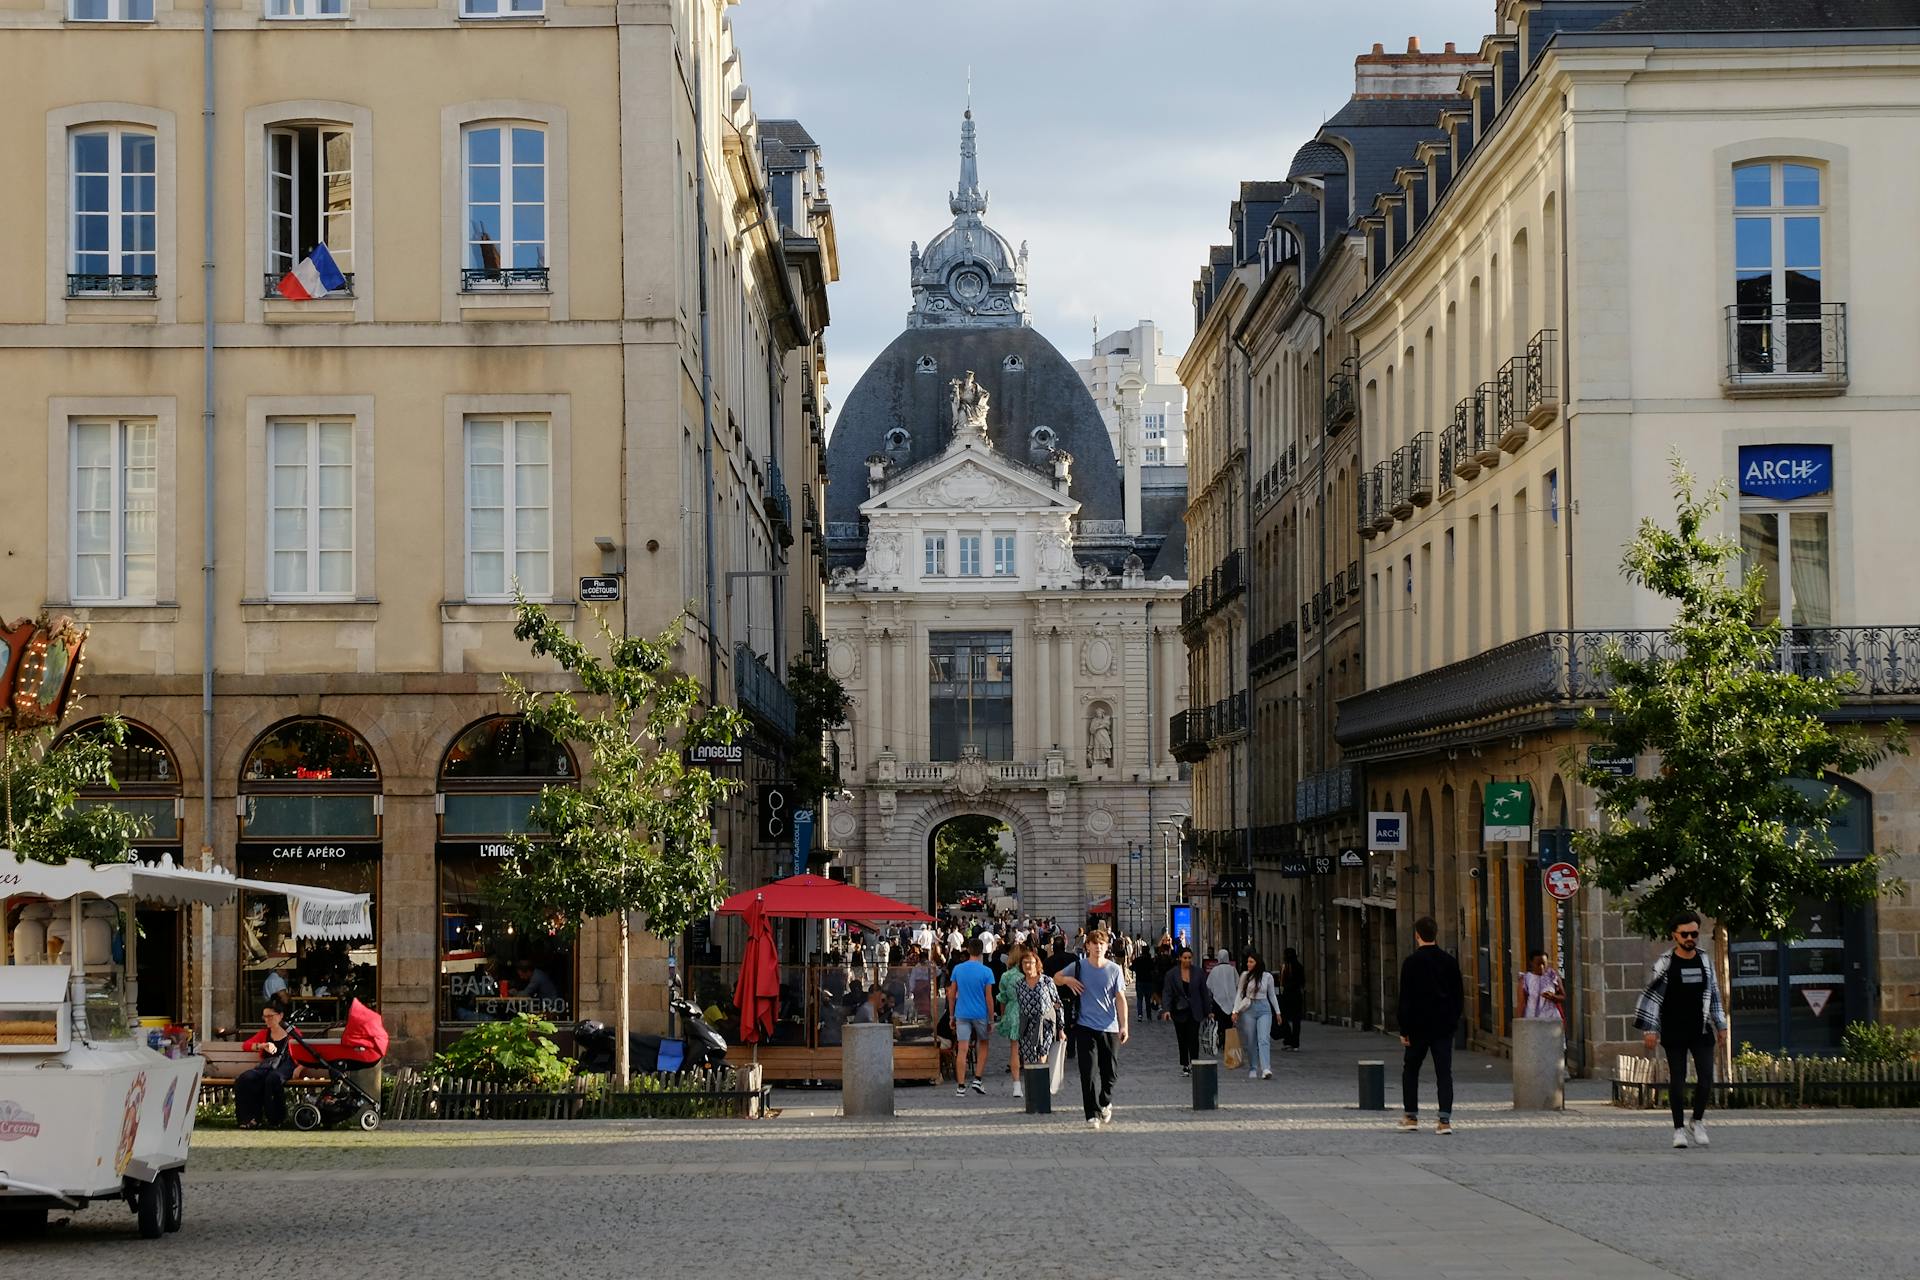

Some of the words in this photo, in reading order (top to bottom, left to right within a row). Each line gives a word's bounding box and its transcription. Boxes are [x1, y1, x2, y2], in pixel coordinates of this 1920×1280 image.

[272, 846, 303, 858] CAFÉ
[306, 846, 346, 858] APÉRO
[451, 975, 495, 996] BAR
[1, 1121, 38, 1136] Cream
